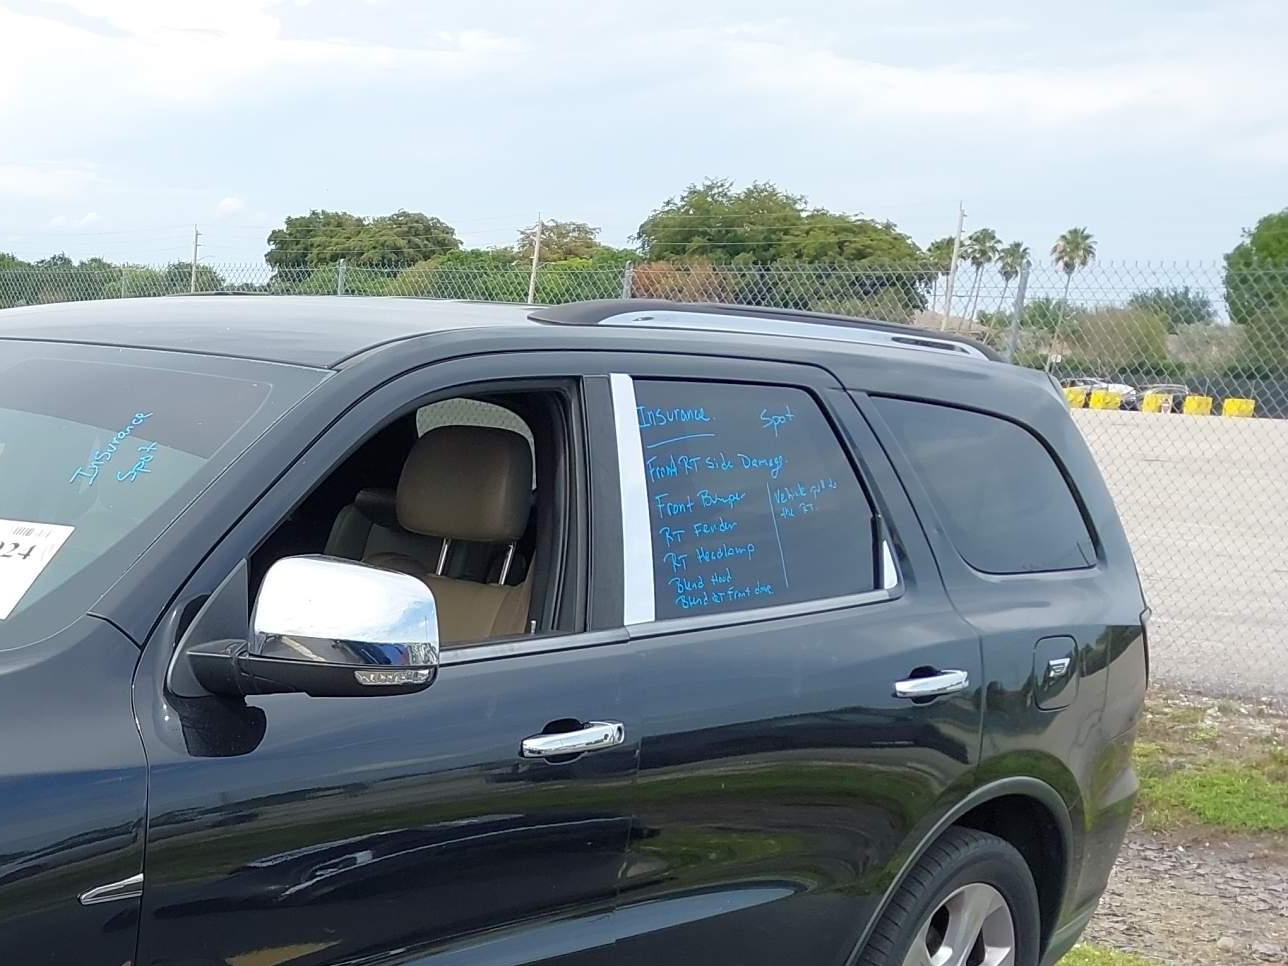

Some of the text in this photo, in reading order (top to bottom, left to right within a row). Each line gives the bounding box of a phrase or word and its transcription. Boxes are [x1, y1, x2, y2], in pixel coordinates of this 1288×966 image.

[760, 405, 795, 438] Spot
[69, 411, 153, 485] Insurance
[117, 441, 158, 481] Spot
[679, 456, 701, 476] RT
[655, 489, 746, 519] Front Bumper
[659, 516, 737, 548] RT Fender
[663, 543, 754, 573] RT Headlamp
[668, 575, 705, 594] Blend
[675, 591, 708, 609] Blend
